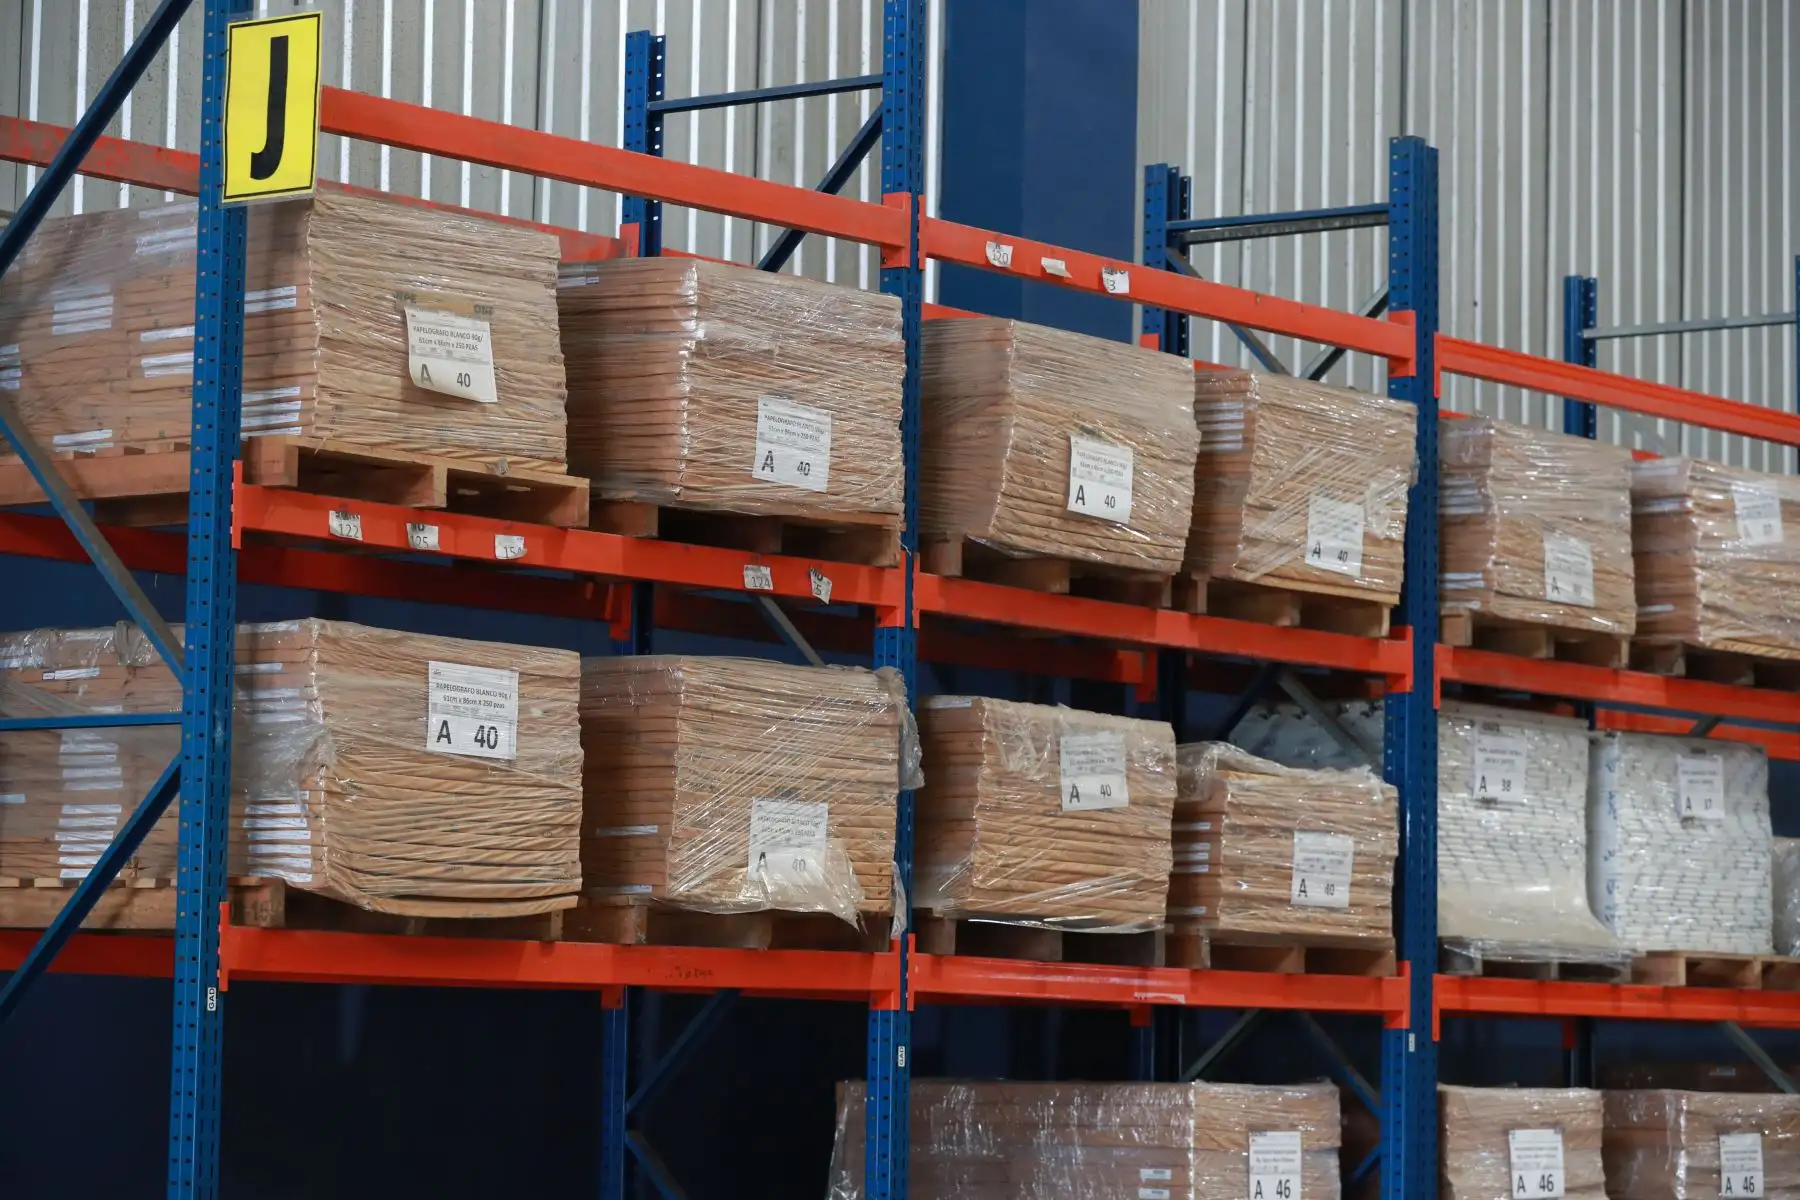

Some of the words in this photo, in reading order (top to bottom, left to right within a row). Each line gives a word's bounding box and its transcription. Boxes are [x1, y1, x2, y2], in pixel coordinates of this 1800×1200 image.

[250, 35, 289, 180] J
[420, 363, 434, 387] A
[456, 372, 471, 388] 40
[761, 450, 774, 473] A
[797, 461, 811, 476] 40
[1075, 484, 1086, 506] A
[1104, 494, 1116, 509] 40
[339, 523, 360, 539] 122
[475, 688, 497, 697] BLANCO
[436, 720, 452, 745] A
[474, 725, 499, 750] 40
[1069, 783, 1080, 804] A
[1100, 784, 1112, 797] 40
[1479, 775, 1487, 793] A
[1685, 796, 1693, 812] A
[756, 852, 769, 873] A
[1298, 878, 1308, 898] A
[1254, 1179, 1263, 1199] A
[1276, 1179, 1291, 1199] 46
[1517, 1175, 1526, 1193] A
[1539, 1174, 1554, 1192] 46
[1725, 1176, 1733, 1193] A
[1743, 1175, 1755, 1193] 46
